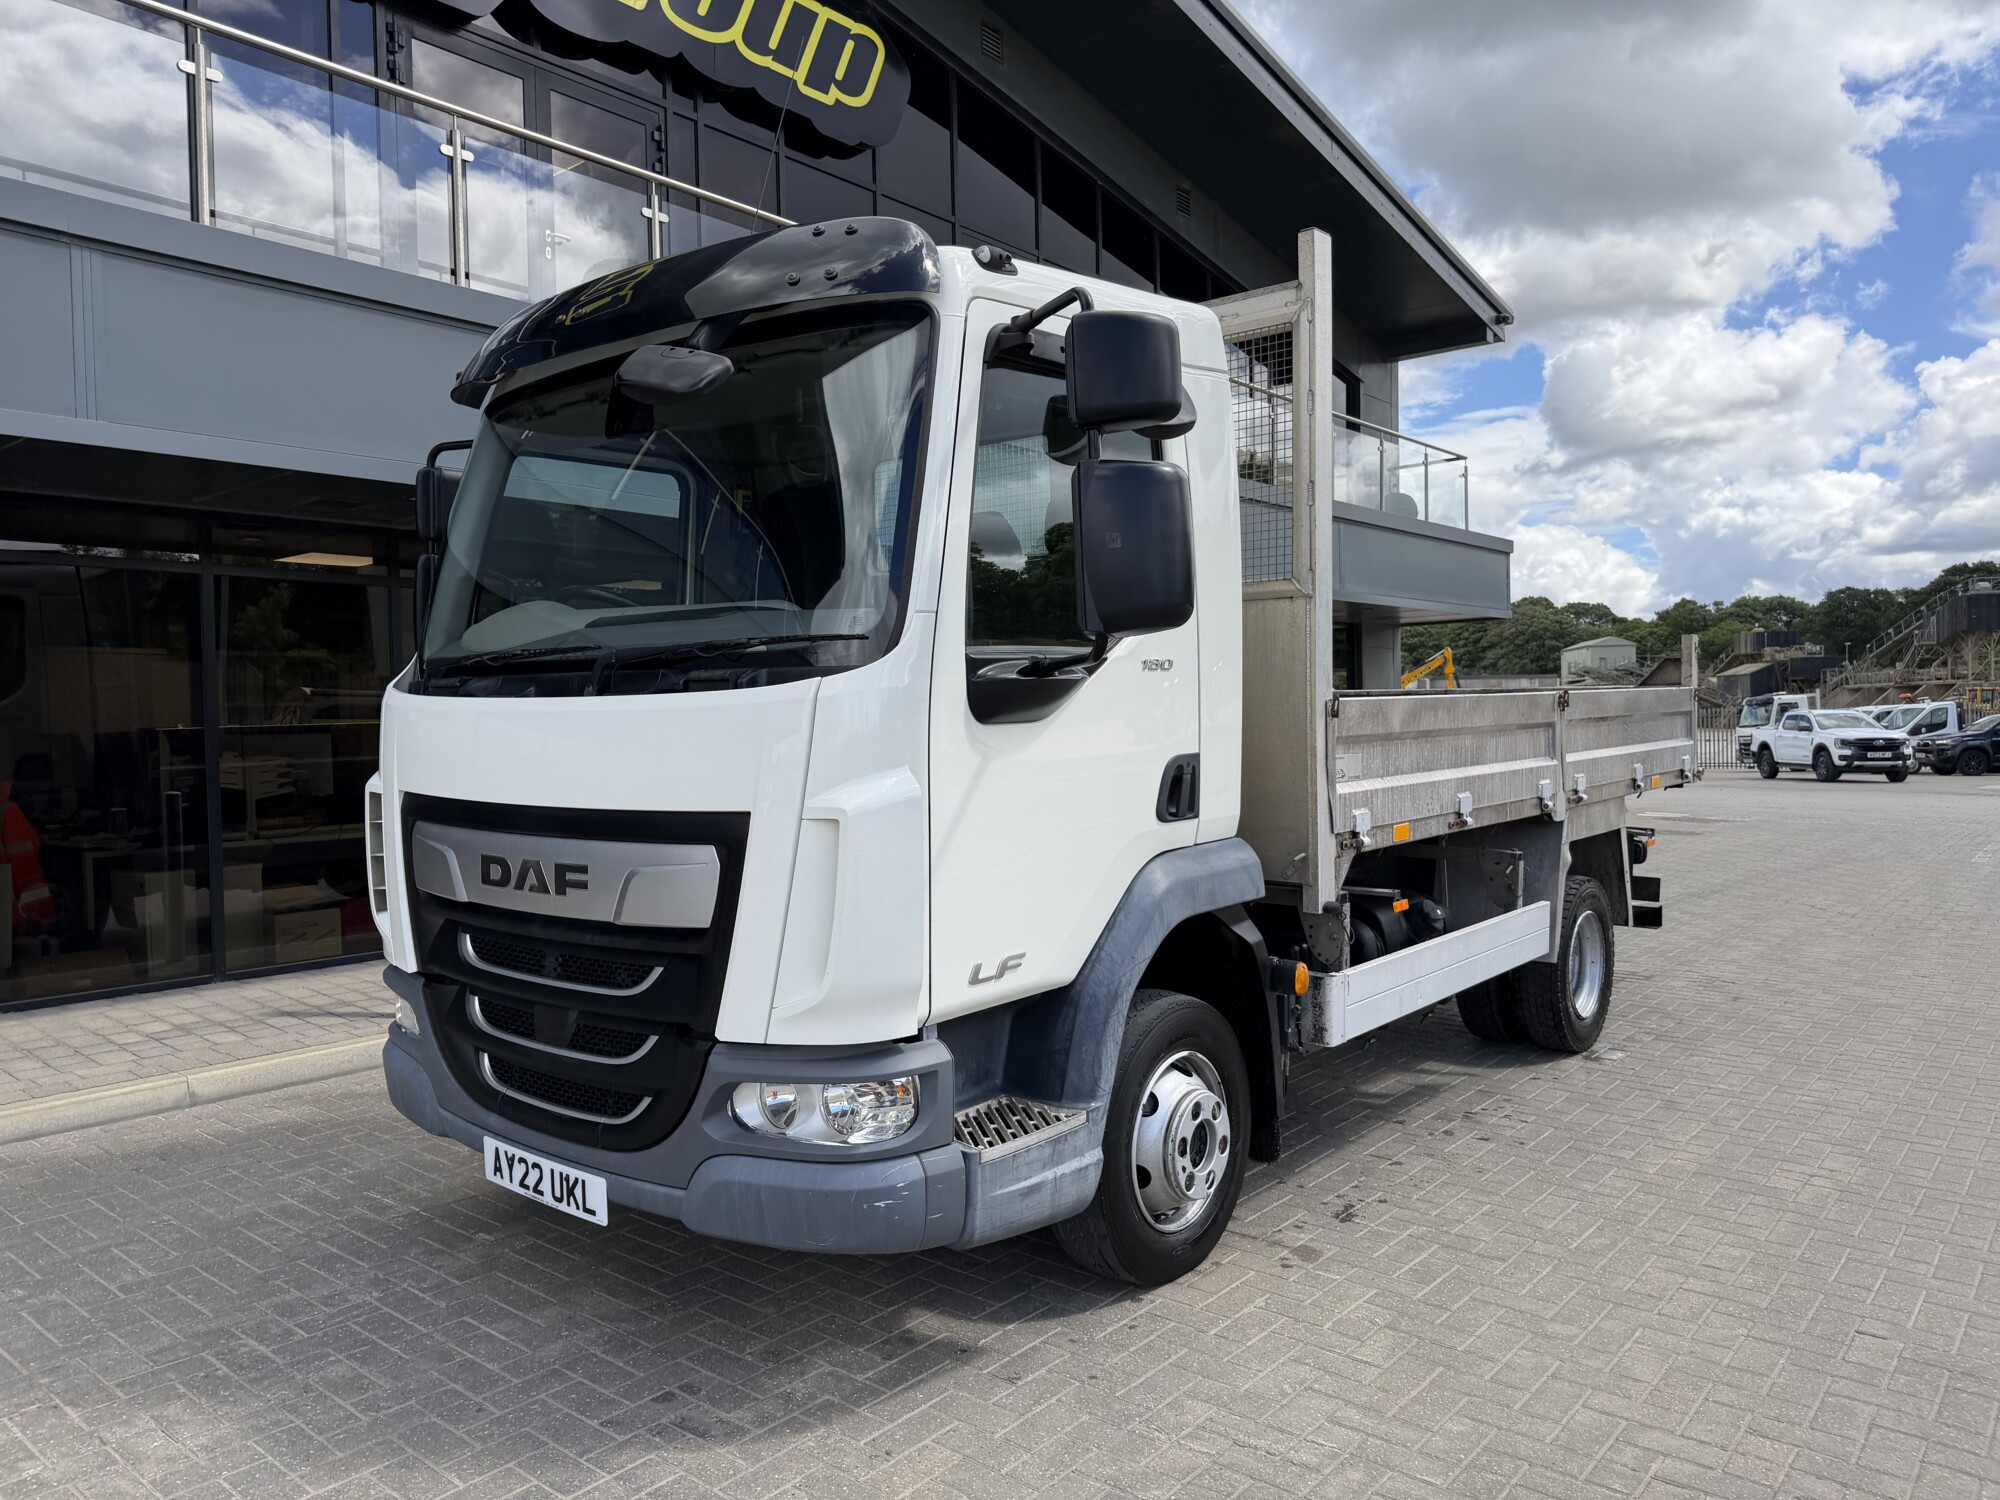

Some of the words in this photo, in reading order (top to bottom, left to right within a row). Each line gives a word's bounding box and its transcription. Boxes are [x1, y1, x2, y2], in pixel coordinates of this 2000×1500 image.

[1141, 659, 1174, 672] 180
[480, 853, 589, 896] DAF
[967, 952, 1026, 986] LF
[493, 1146, 545, 1197] AY22
[550, 1168, 597, 1217] UKL
